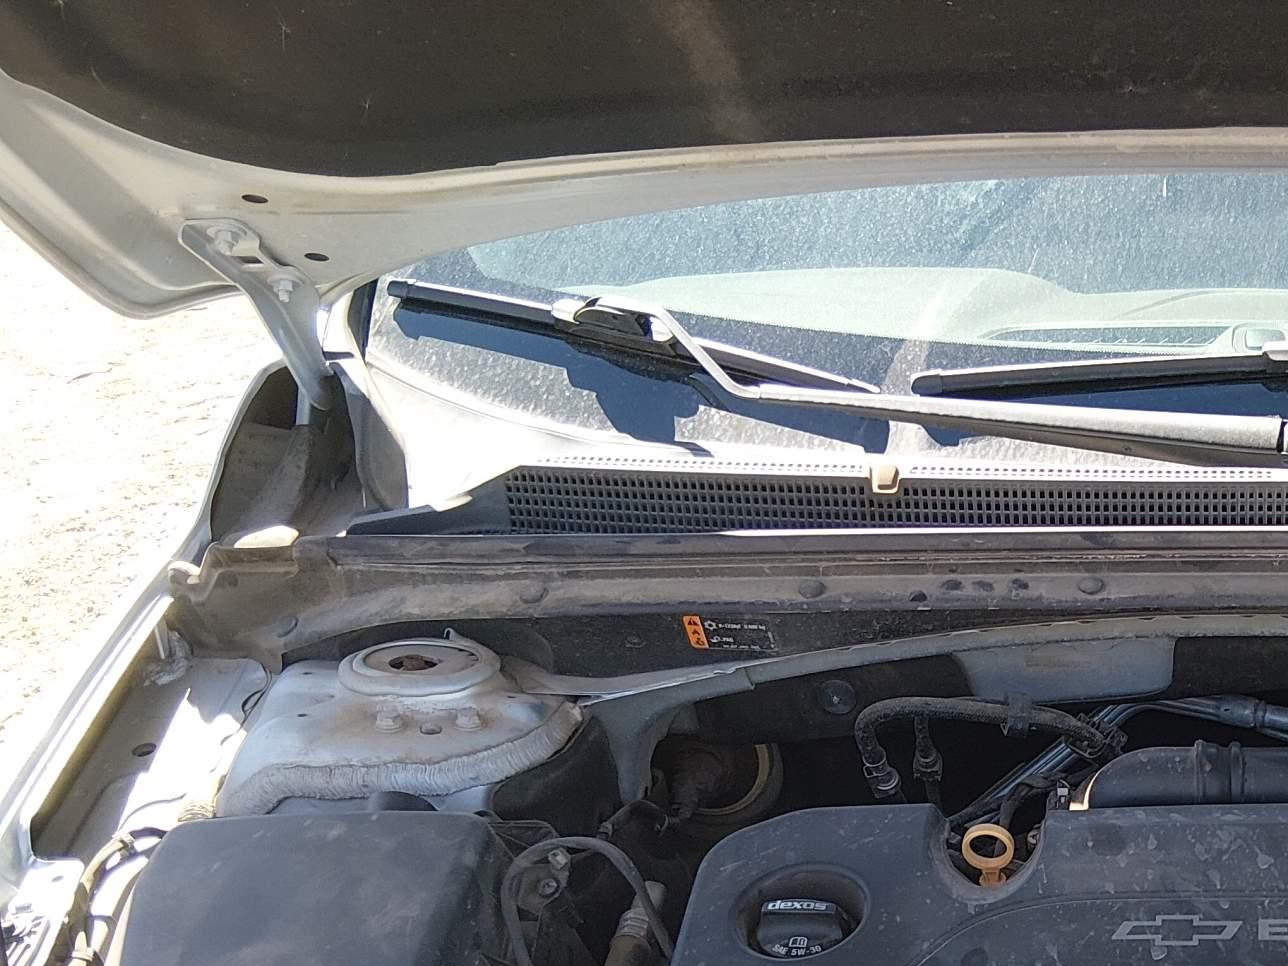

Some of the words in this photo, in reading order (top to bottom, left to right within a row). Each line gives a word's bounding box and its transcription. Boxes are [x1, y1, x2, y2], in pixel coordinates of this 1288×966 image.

[767, 900, 828, 911] dexos
[772, 944, 789, 955] SAE
[790, 945, 823, 956] 5W-30
